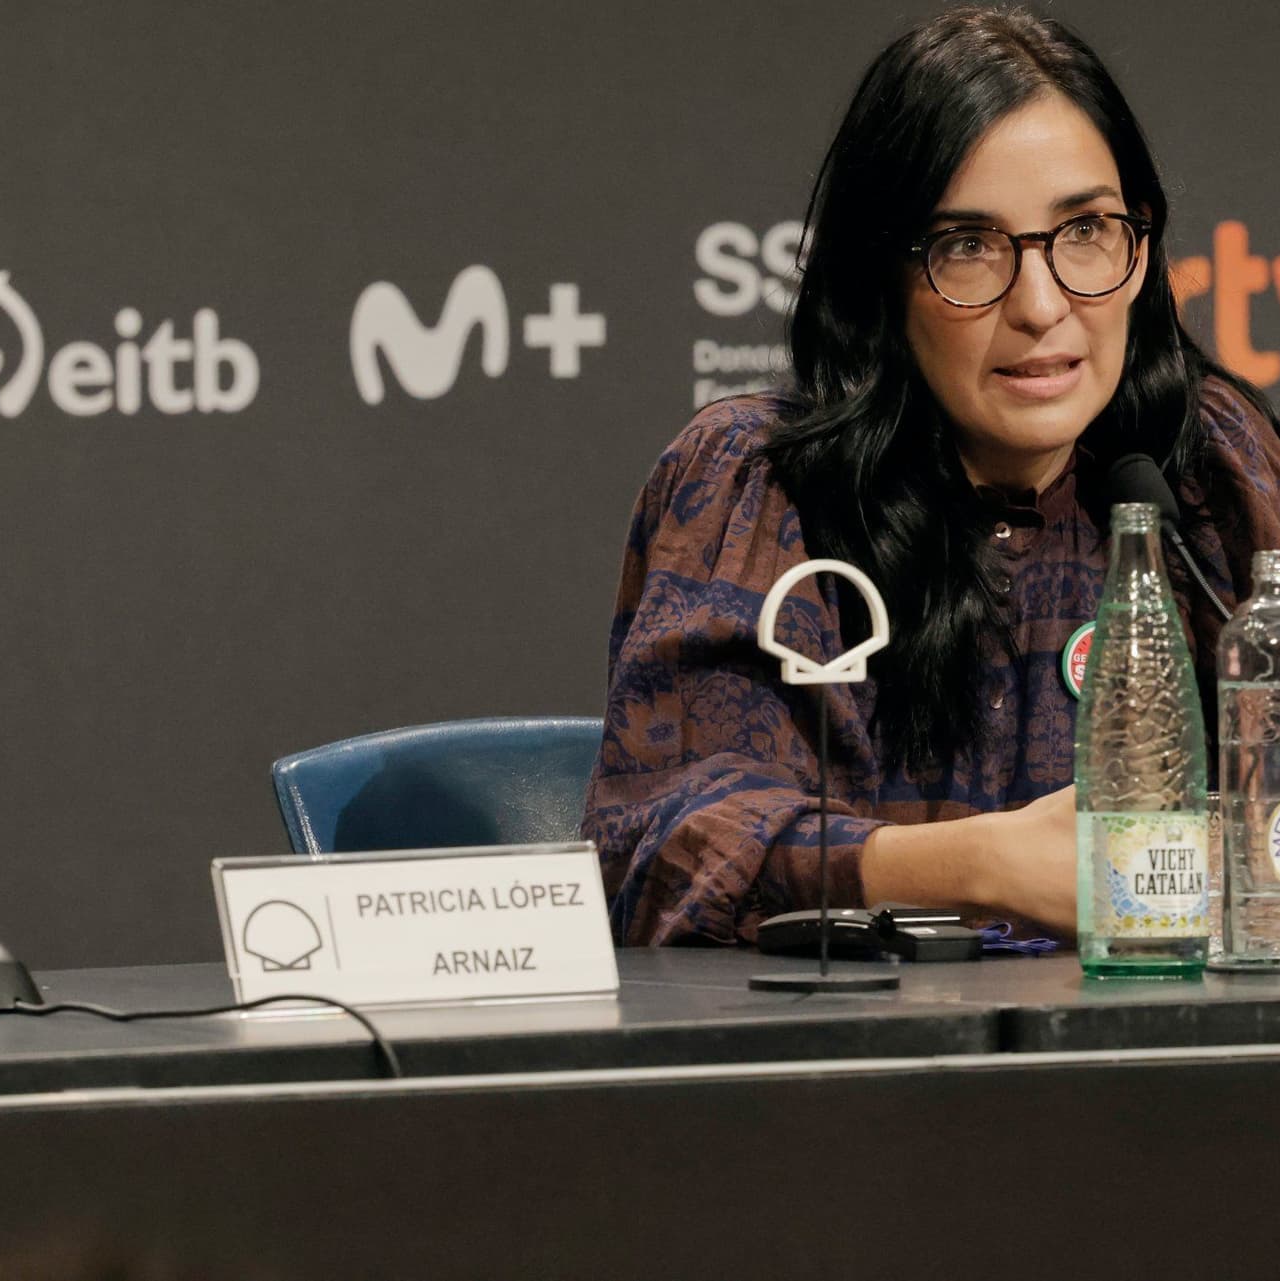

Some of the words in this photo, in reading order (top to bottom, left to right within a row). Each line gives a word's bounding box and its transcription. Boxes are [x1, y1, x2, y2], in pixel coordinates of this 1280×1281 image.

[48, 308, 260, 416] eitb
[1148, 848, 1195, 871] VICHY
[1135, 873, 1203, 895] CATALAN
[356, 887, 485, 918] PATRICIA
[492, 880, 585, 911] LÓPEZ
[432, 947, 537, 976] ARNAIZ
